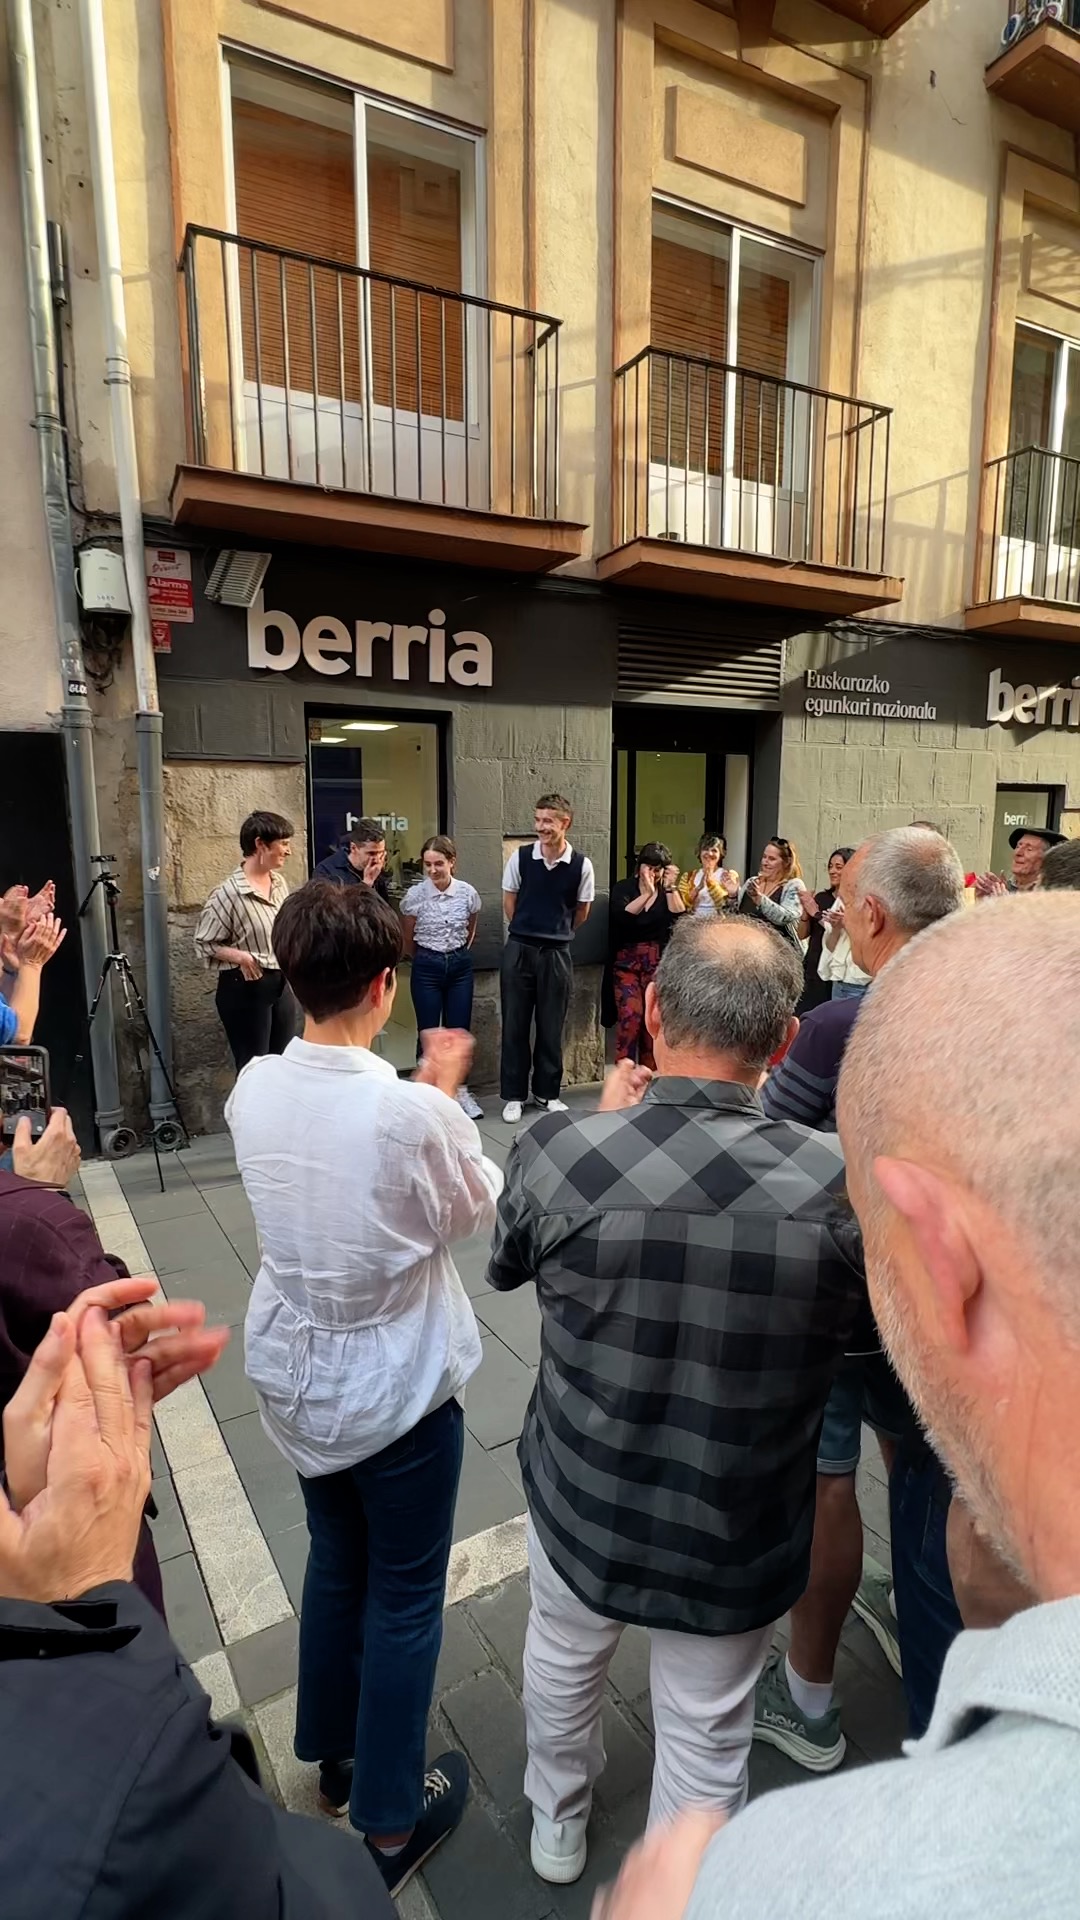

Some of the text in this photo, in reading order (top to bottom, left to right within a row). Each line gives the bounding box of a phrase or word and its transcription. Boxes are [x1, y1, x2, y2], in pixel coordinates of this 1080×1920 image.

[149, 577, 189, 590] Alarma
[247, 588, 493, 687] berria
[806, 669, 890, 694] Euskarazko
[805, 696, 937, 720] egunkari nazionala
